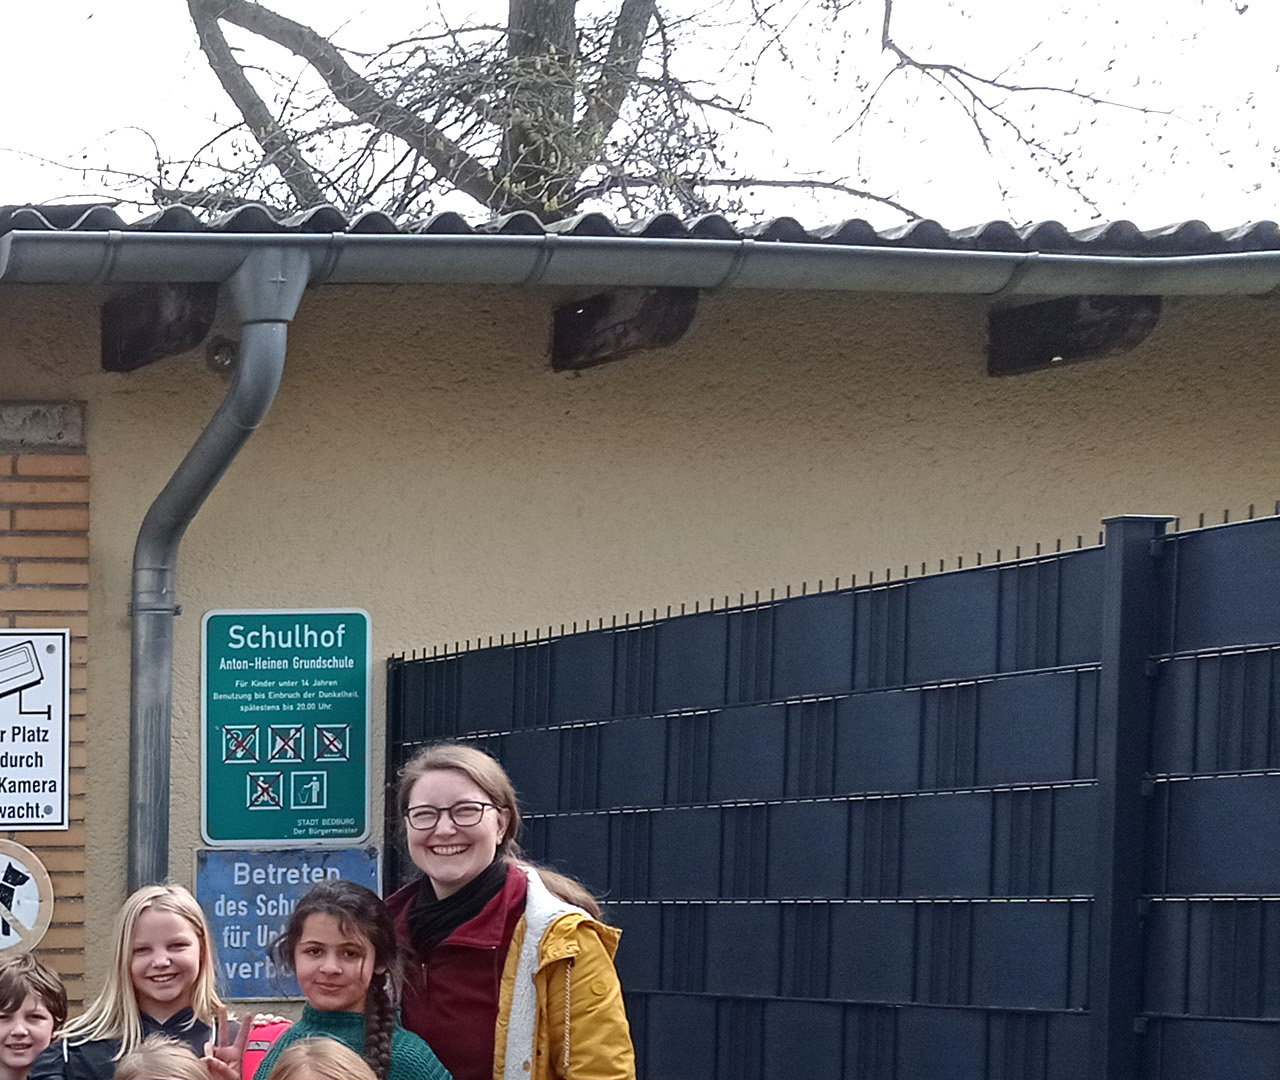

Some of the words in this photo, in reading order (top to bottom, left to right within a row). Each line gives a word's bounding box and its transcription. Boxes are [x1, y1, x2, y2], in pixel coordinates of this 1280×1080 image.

[228, 624, 345, 648] Schulhof
[219, 656, 288, 670] Anton-Heinen
[293, 656, 354, 669] Grundschule
[235, 679, 248, 687] Für
[251, 679, 275, 687] Kinder
[278, 679, 298, 687] unter
[301, 679, 309, 687] 14
[312, 679, 338, 687] Jahren
[213, 692, 252, 701] Benutzung
[254, 691, 265, 699] bis
[268, 691, 300, 699] Einbruch
[240, 704, 280, 712] spätestens
[282, 703, 293, 711] bis
[12, 726, 49, 742] Platz
[0, 751, 43, 768] durch
[321, 818, 355, 826] BEDBURG
[309, 827, 358, 836] Bürgermeister
[234, 863, 340, 885] Betreten
[215, 894, 248, 917] des
[223, 926, 250, 948] für
